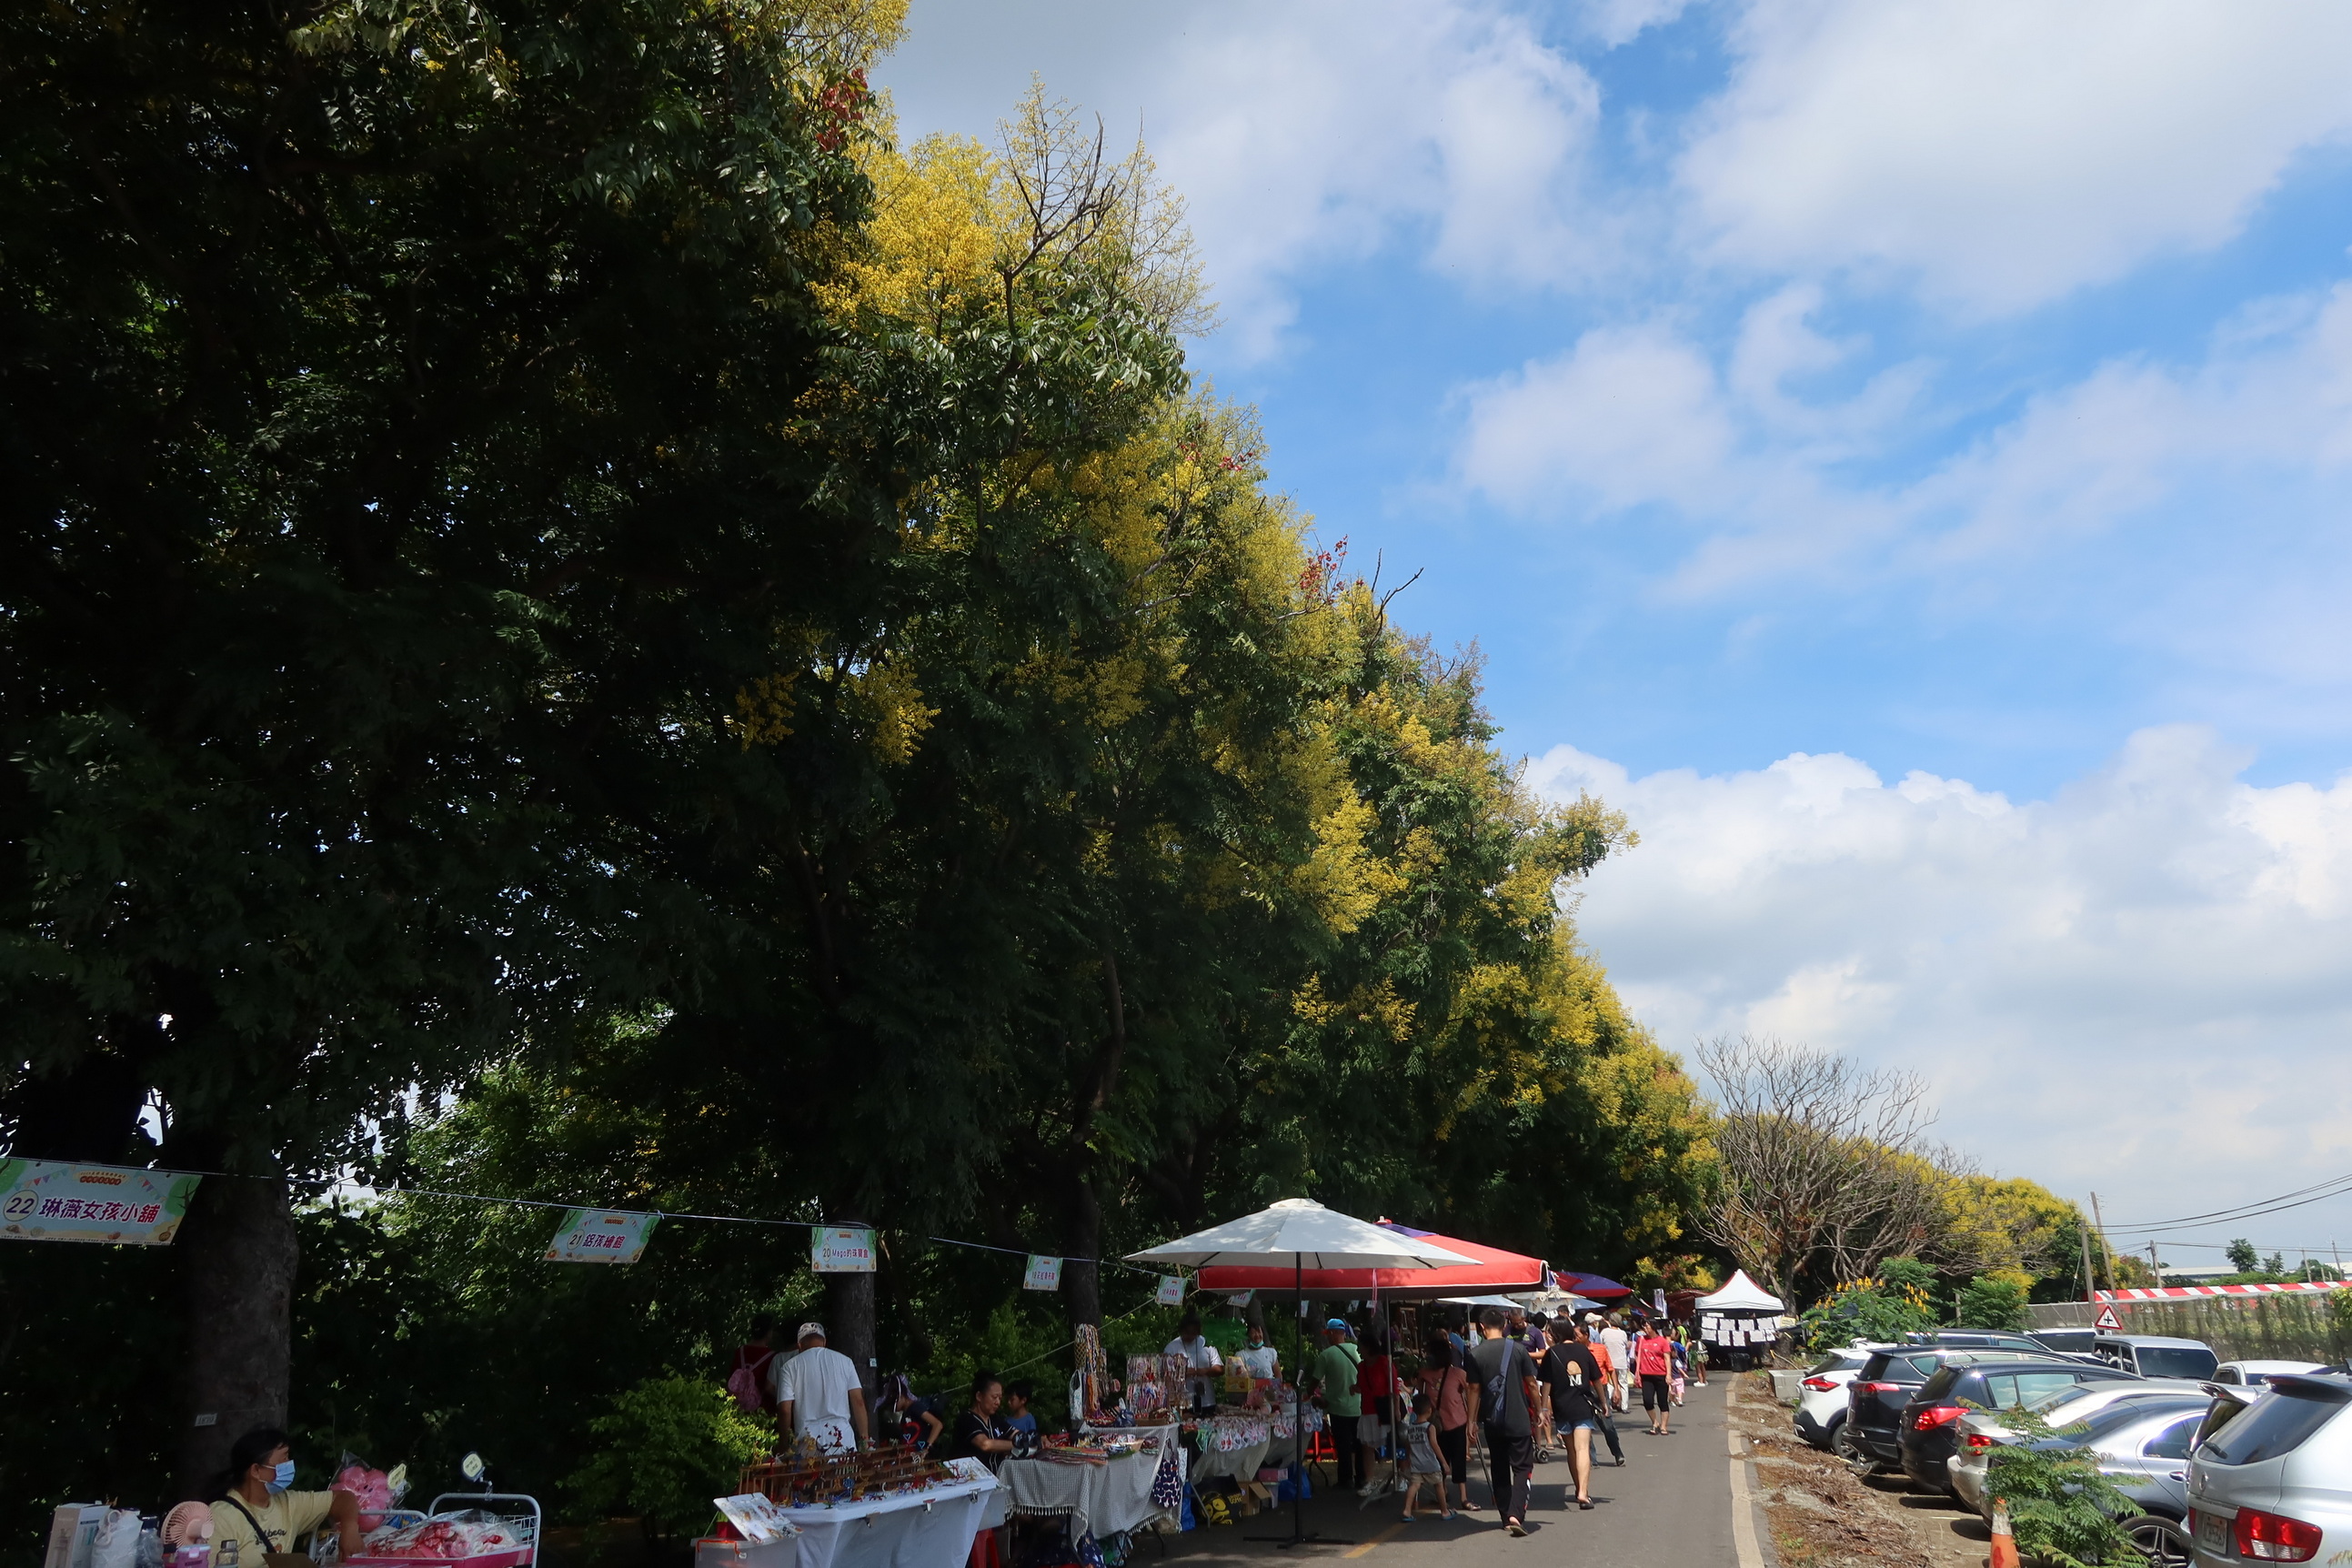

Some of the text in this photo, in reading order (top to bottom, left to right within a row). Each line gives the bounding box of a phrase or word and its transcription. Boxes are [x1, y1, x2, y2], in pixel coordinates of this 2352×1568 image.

[6, 1198, 161, 1223] 22 琳薇女孩小舖
[569, 1234, 582, 1245] 21
[823, 1249, 830, 1257] 20
